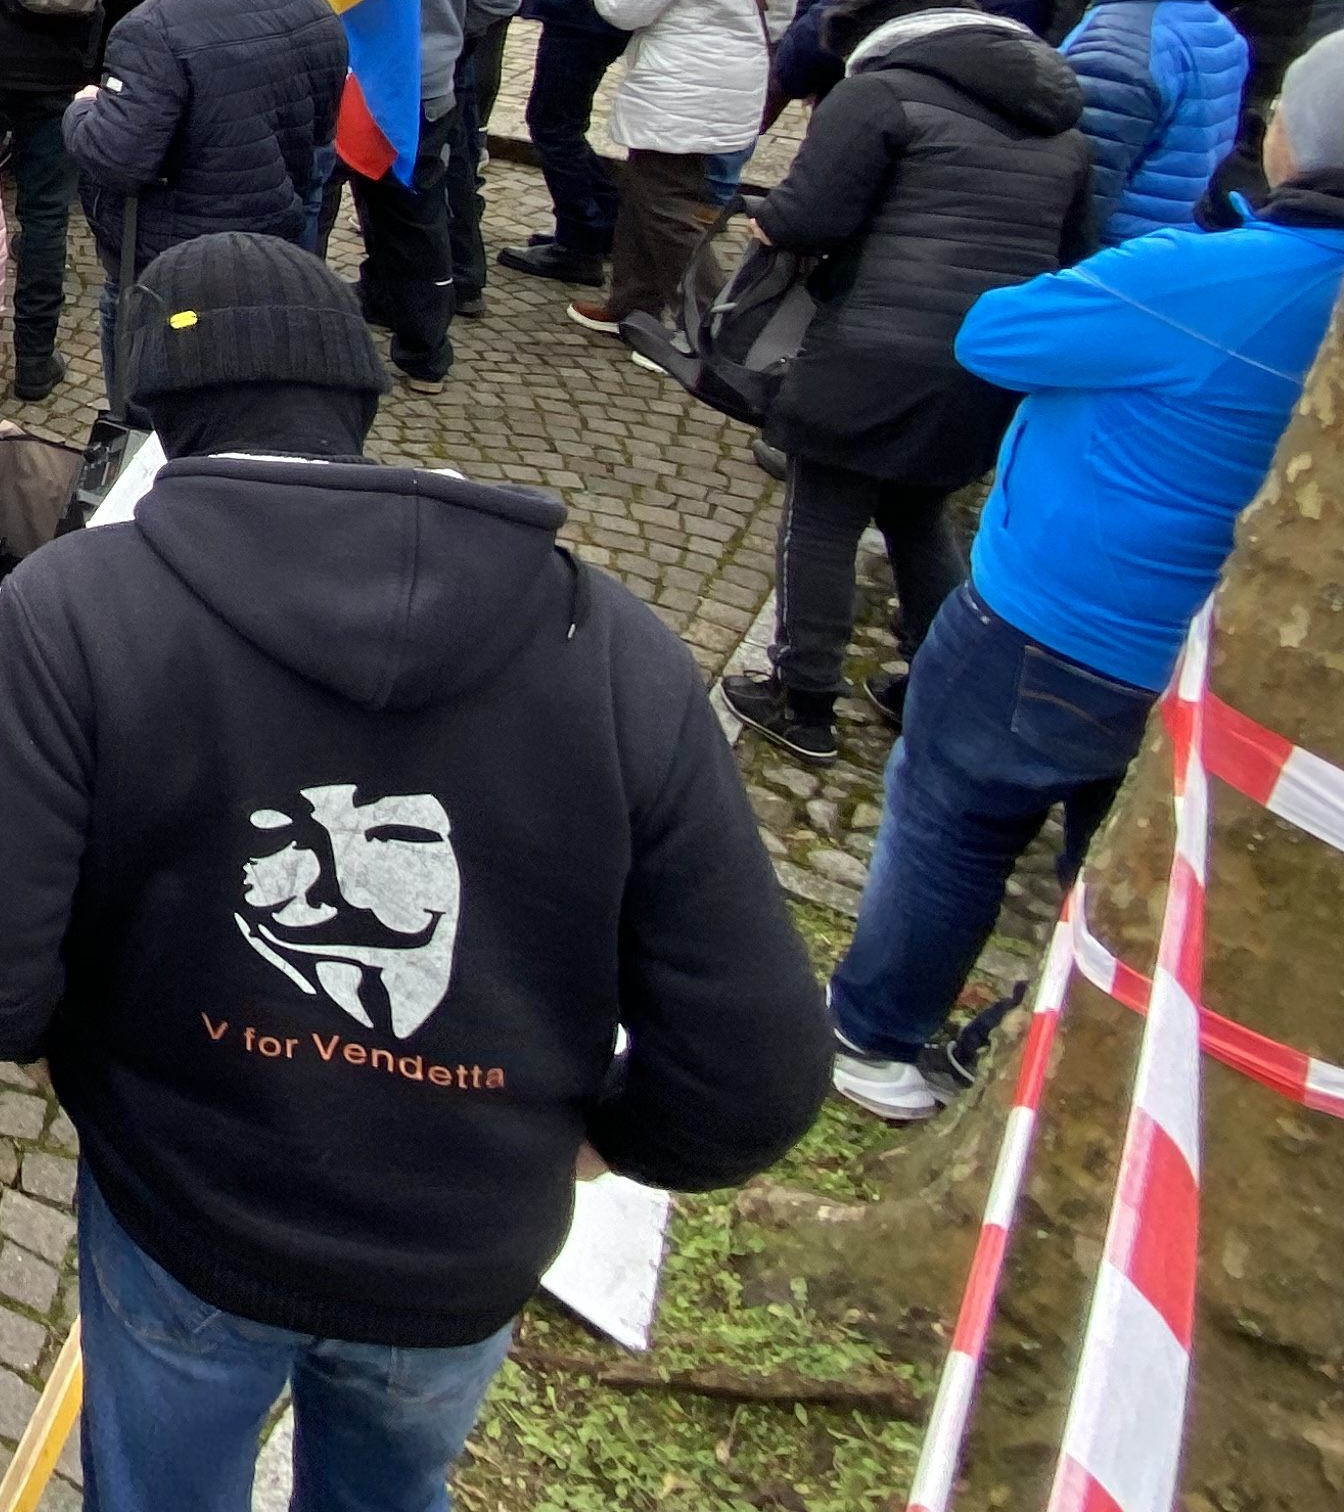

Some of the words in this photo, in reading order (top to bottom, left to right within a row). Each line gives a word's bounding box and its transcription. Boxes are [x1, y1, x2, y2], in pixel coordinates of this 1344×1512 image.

[201, 1011, 230, 1041] V
[243, 1026, 300, 1060] for
[311, 1032, 506, 1089] Vendetta
